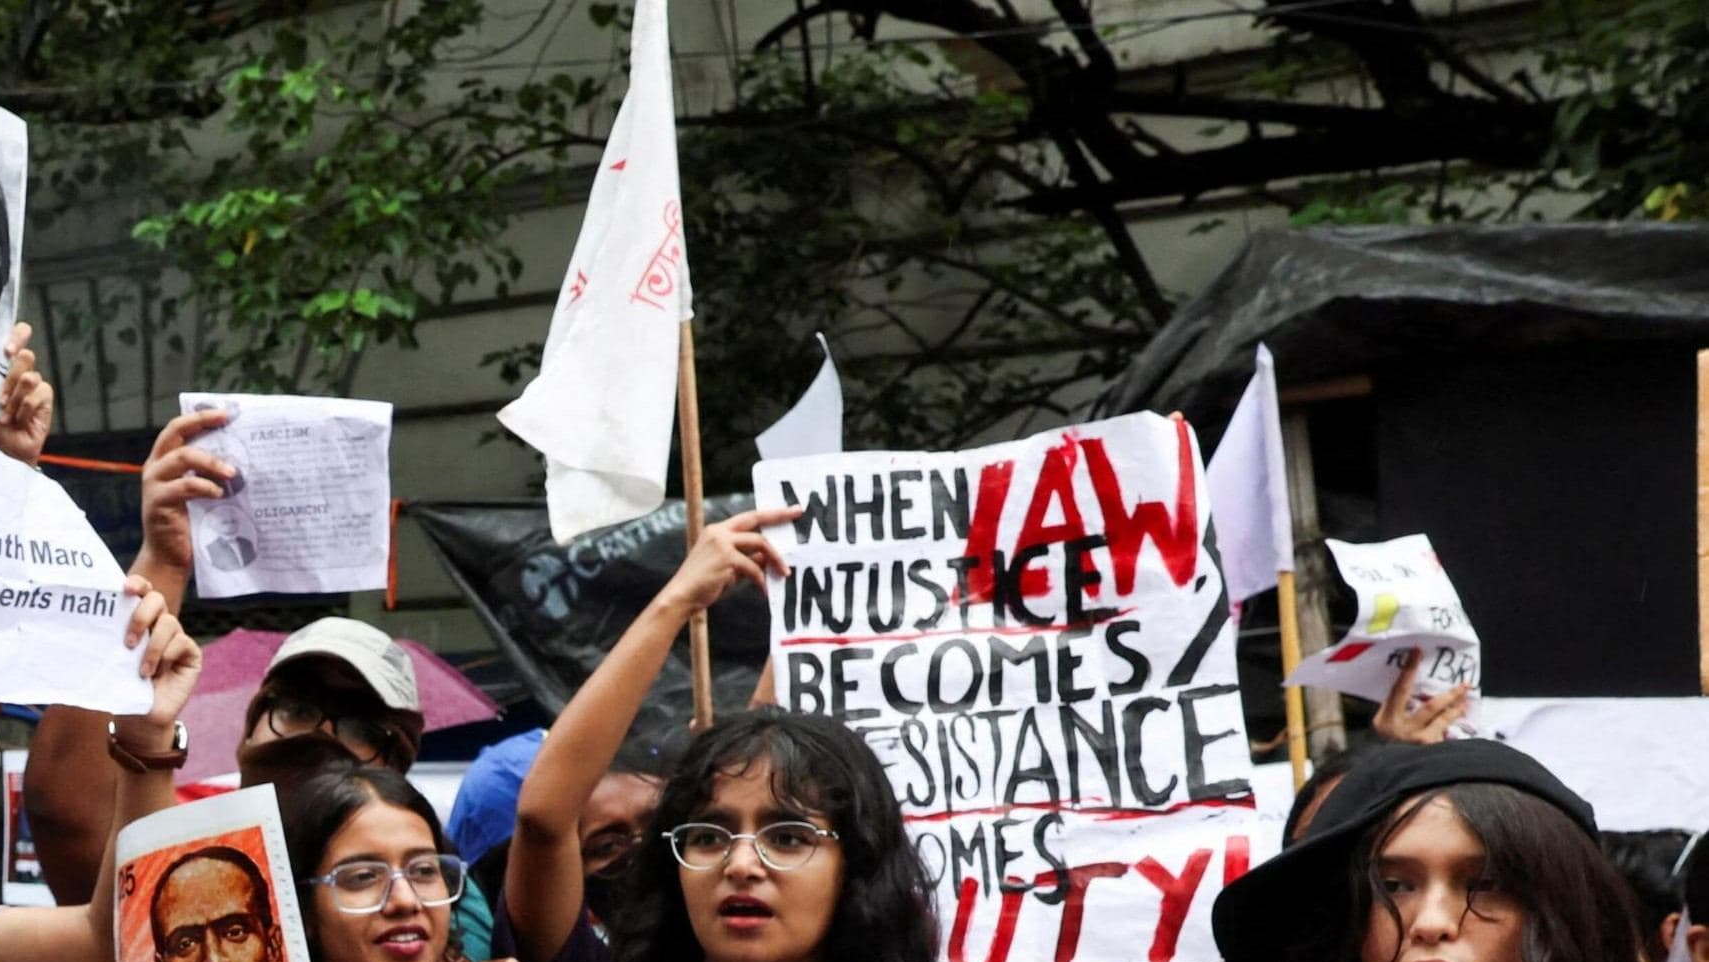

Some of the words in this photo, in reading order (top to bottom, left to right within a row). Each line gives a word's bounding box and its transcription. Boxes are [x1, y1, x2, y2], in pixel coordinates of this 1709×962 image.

[780, 466, 970, 545] WHEN
[30, 540, 94, 568] Maro
[783, 534, 1121, 634] INJUSTICE
[61, 592, 117, 617] nahi
[858, 684, 1252, 814] ESISTANCE
[915, 813, 1070, 904] OMES
